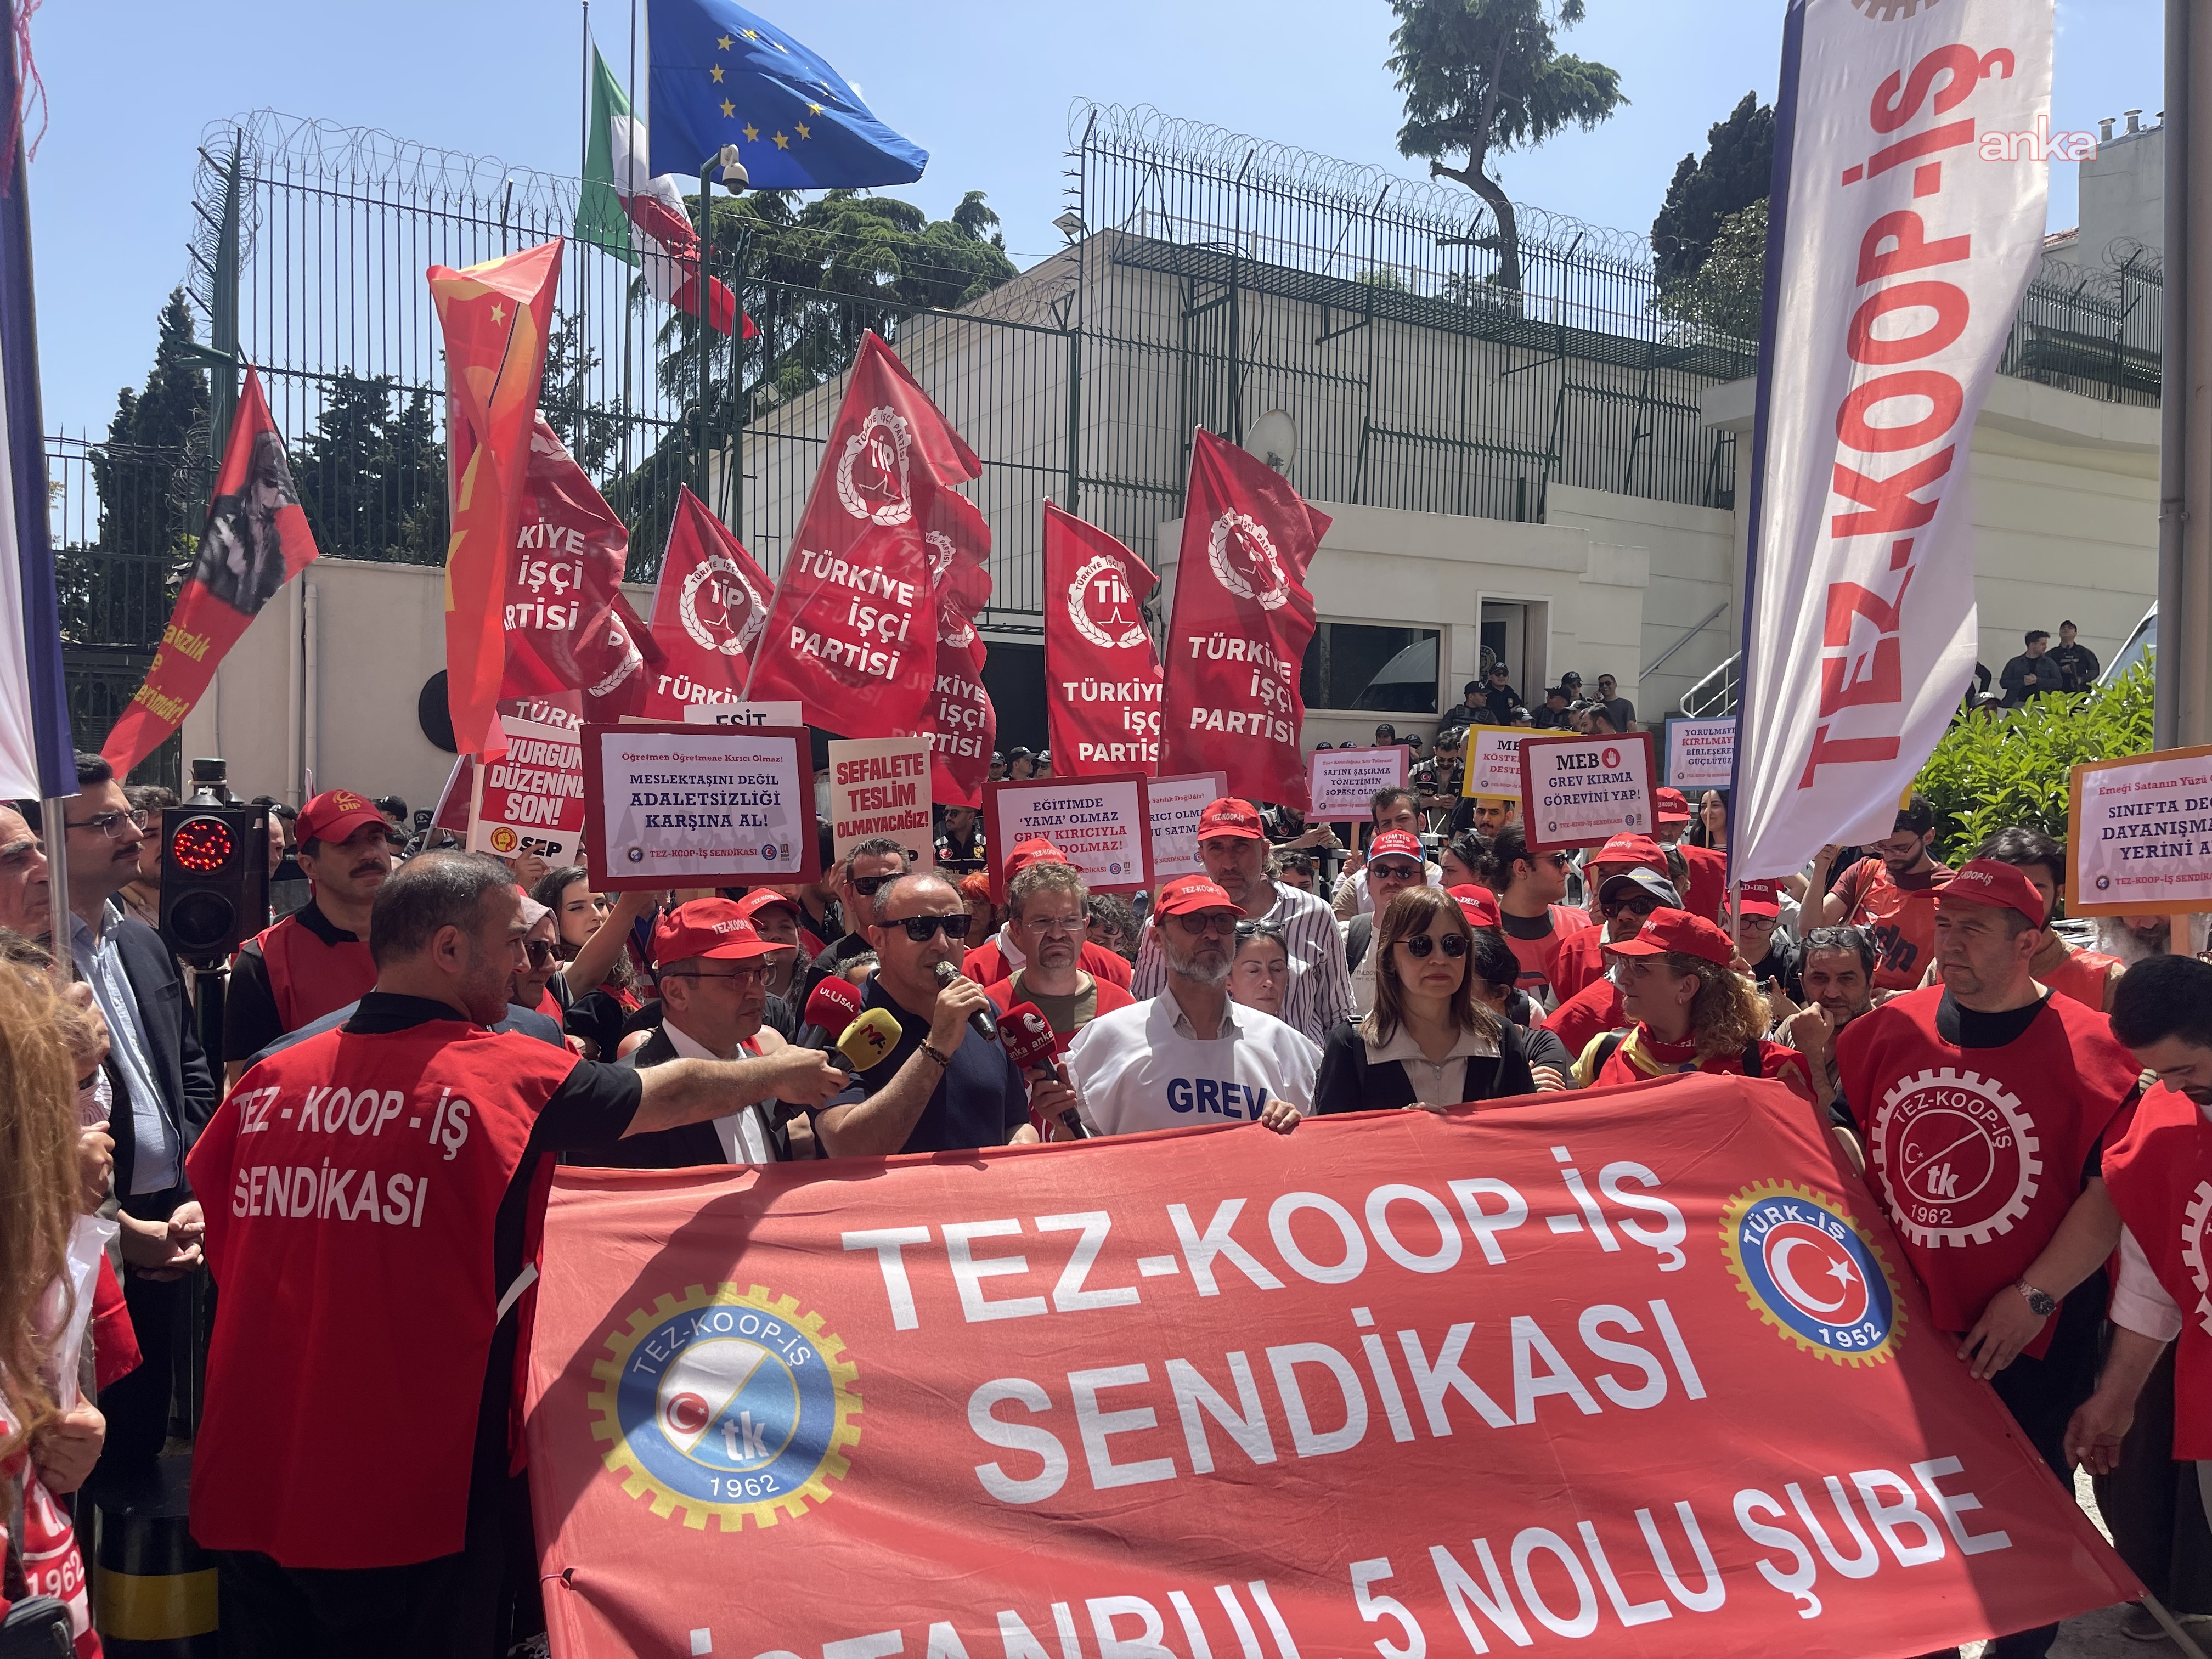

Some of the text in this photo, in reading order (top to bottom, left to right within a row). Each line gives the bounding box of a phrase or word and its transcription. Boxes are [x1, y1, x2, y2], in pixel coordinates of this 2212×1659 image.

[1797, 44, 2016, 791] TEZ-KOOP-İŞ
[518, 555, 583, 595] İŞÇİ
[800, 549, 915, 608] TÜRKİYE
[1075, 561, 1102, 590] TÜRKİYE
[1105, 560, 1119, 568] İŞÇİ
[711, 579, 745, 611] TİP
[848, 595, 912, 643] İŞÇİ
[790, 626, 899, 681] PARTİSİ
[1189, 632, 1291, 685] TÜRKİYE
[1250, 669, 1293, 714] İŞÇİ
[939, 697, 986, 731] İŞÇİ
[1190, 707, 1295, 747] PARTİSİ
[622, 751, 783, 763] Öğretmen Öğretmene Kırıcı Olmaz!
[913, 730, 983, 758] RTİSİ
[837, 753, 924, 785] SEFALETE
[1353, 768, 1391, 776] ŞAŞIRMA
[1556, 753, 1599, 770] MEB
[1688, 757, 1731, 766] GÜÇLÜYÜZ
[630, 773, 779, 787] MESLEKTAŞINI DEĞİL
[1331, 777, 1381, 786] YÖNETİMİN
[1549, 772, 1633, 788] GREV KIRMA
[2099, 783, 2131, 795] Emeği
[2135, 780, 2177, 791] Satanın
[2179, 775, 2207, 786] Yüzü
[630, 790, 781, 806] ADALETSİZLİĞİ
[848, 780, 916, 812] TESLİM
[1032, 798, 1103, 811] EĞİTİMDE
[1544, 789, 1640, 806] GÖREVİNİ YAP!
[504, 793, 563, 826] SON!
[646, 814, 768, 831] KARŞINA AL!
[1070, 812, 1119, 823] OLMAZ
[1211, 812, 1244, 823] TEZ-KOOP-İŞ
[2108, 800, 2179, 819] SINIFTA
[837, 810, 929, 838] OLMAYACAĞIZ!
[1055, 826, 1127, 839] KIRICIYLA
[1559, 819, 1592, 828] TEZ-KOOP-İŞ
[518, 837, 562, 857] SEP
[650, 847, 757, 859] TEZ-KOOP-İŞ SENDİKASI
[1059, 840, 1123, 854] DOLMAZ!
[2120, 839, 2193, 860] YERİNİ
[2116, 874, 2173, 885] TEZ-KOOP-İŞ
[820, 987, 854, 1013] ULUSAL
[1008, 1046, 1028, 1059] anka
[1031, 1031, 1053, 1048] anka
[1167, 1077, 1268, 1120] GREV
[1893, 1090, 2012, 1149] TEZ-KOOP-İŞ
[233, 1156, 428, 1227] SENDİKASI
[1927, 1163, 1959, 1198] tk
[1743, 1205, 1846, 1246] TÜRK-İŞ
[1911, 1204, 1953, 1224] 1962
[840, 1146, 1689, 1331] TEZ-KOOP-İŞ
[633, 1312, 811, 1376] TEZ-KOOP-İŞ
[1818, 1322, 1882, 1347] 1952
[967, 1299, 1707, 1505] SENDİKASI
[721, 1410, 769, 1462] tk
[711, 1474, 780, 1498] 1962
[1348, 1557, 1426, 1659] 5
[1429, 1501, 1726, 1655] NOLU
[1733, 1455, 2013, 1620] ŞUBE
[27, 1550, 85, 1599] 1962
